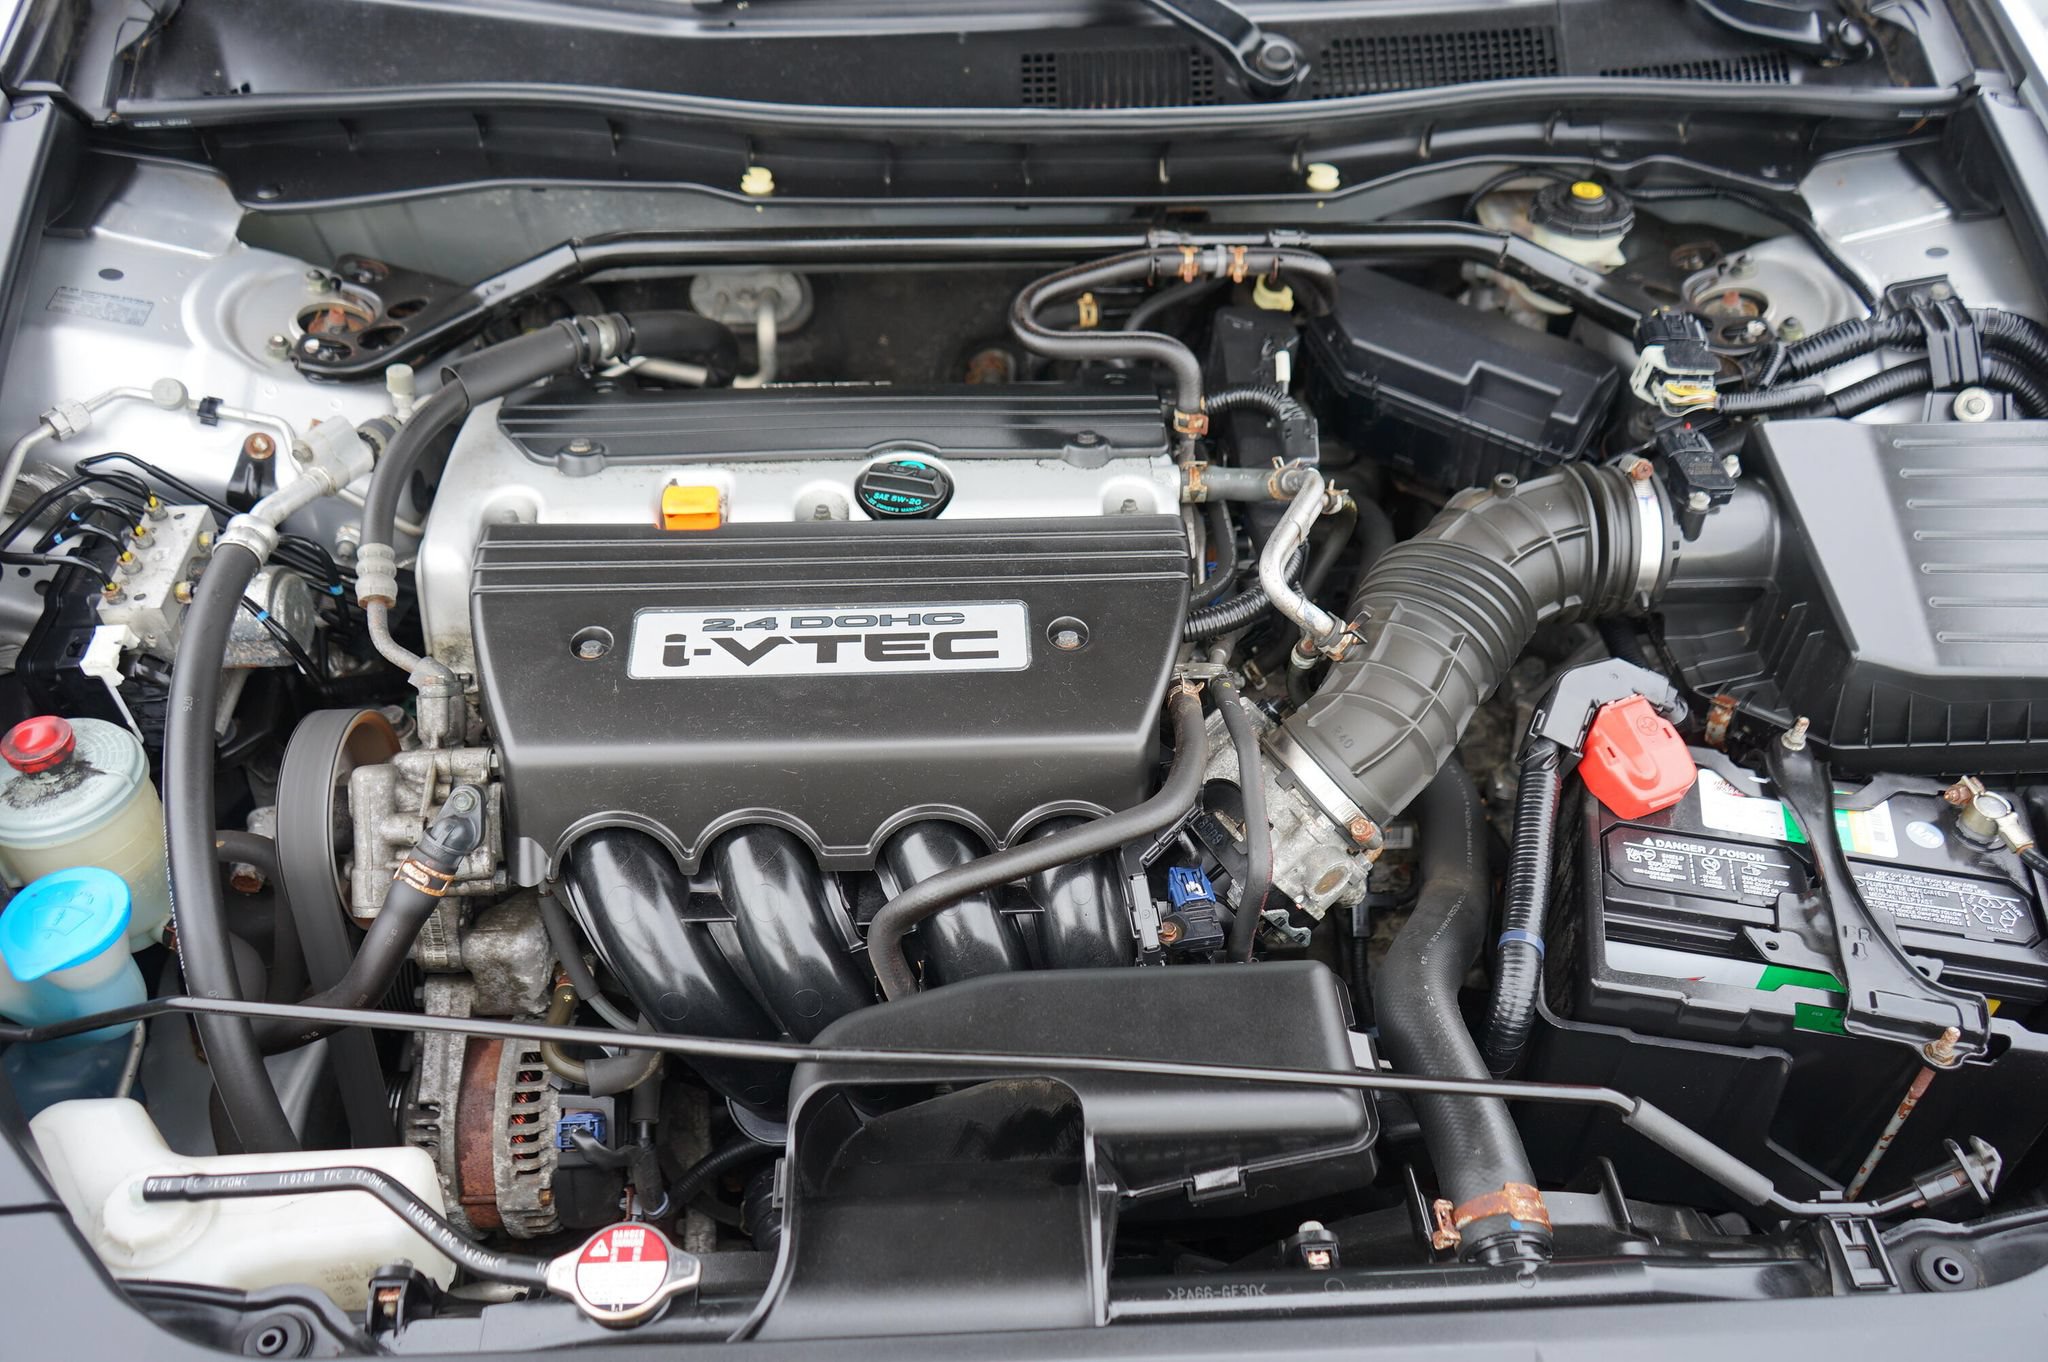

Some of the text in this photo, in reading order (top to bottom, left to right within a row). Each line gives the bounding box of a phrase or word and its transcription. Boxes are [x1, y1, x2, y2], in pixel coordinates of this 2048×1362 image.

[873, 492, 922, 506] SAE 5W-20
[702, 612, 965, 632] 2.4 DOHC
[662, 630, 999, 667] i-VTEC
[1655, 839, 1706, 854] DANGER
[1718, 848, 1766, 862] POISON
[1774, 879, 1790, 887] ACID
[1866, 880, 1887, 889] FLUSH
[1868, 891, 1898, 900] MEDICAL
[1898, 895, 1916, 903] HELP
[323, 1169, 343, 1182] TPC
[439, 1228, 458, 1248] TPC
[611, 1229, 646, 1239] DANGER
